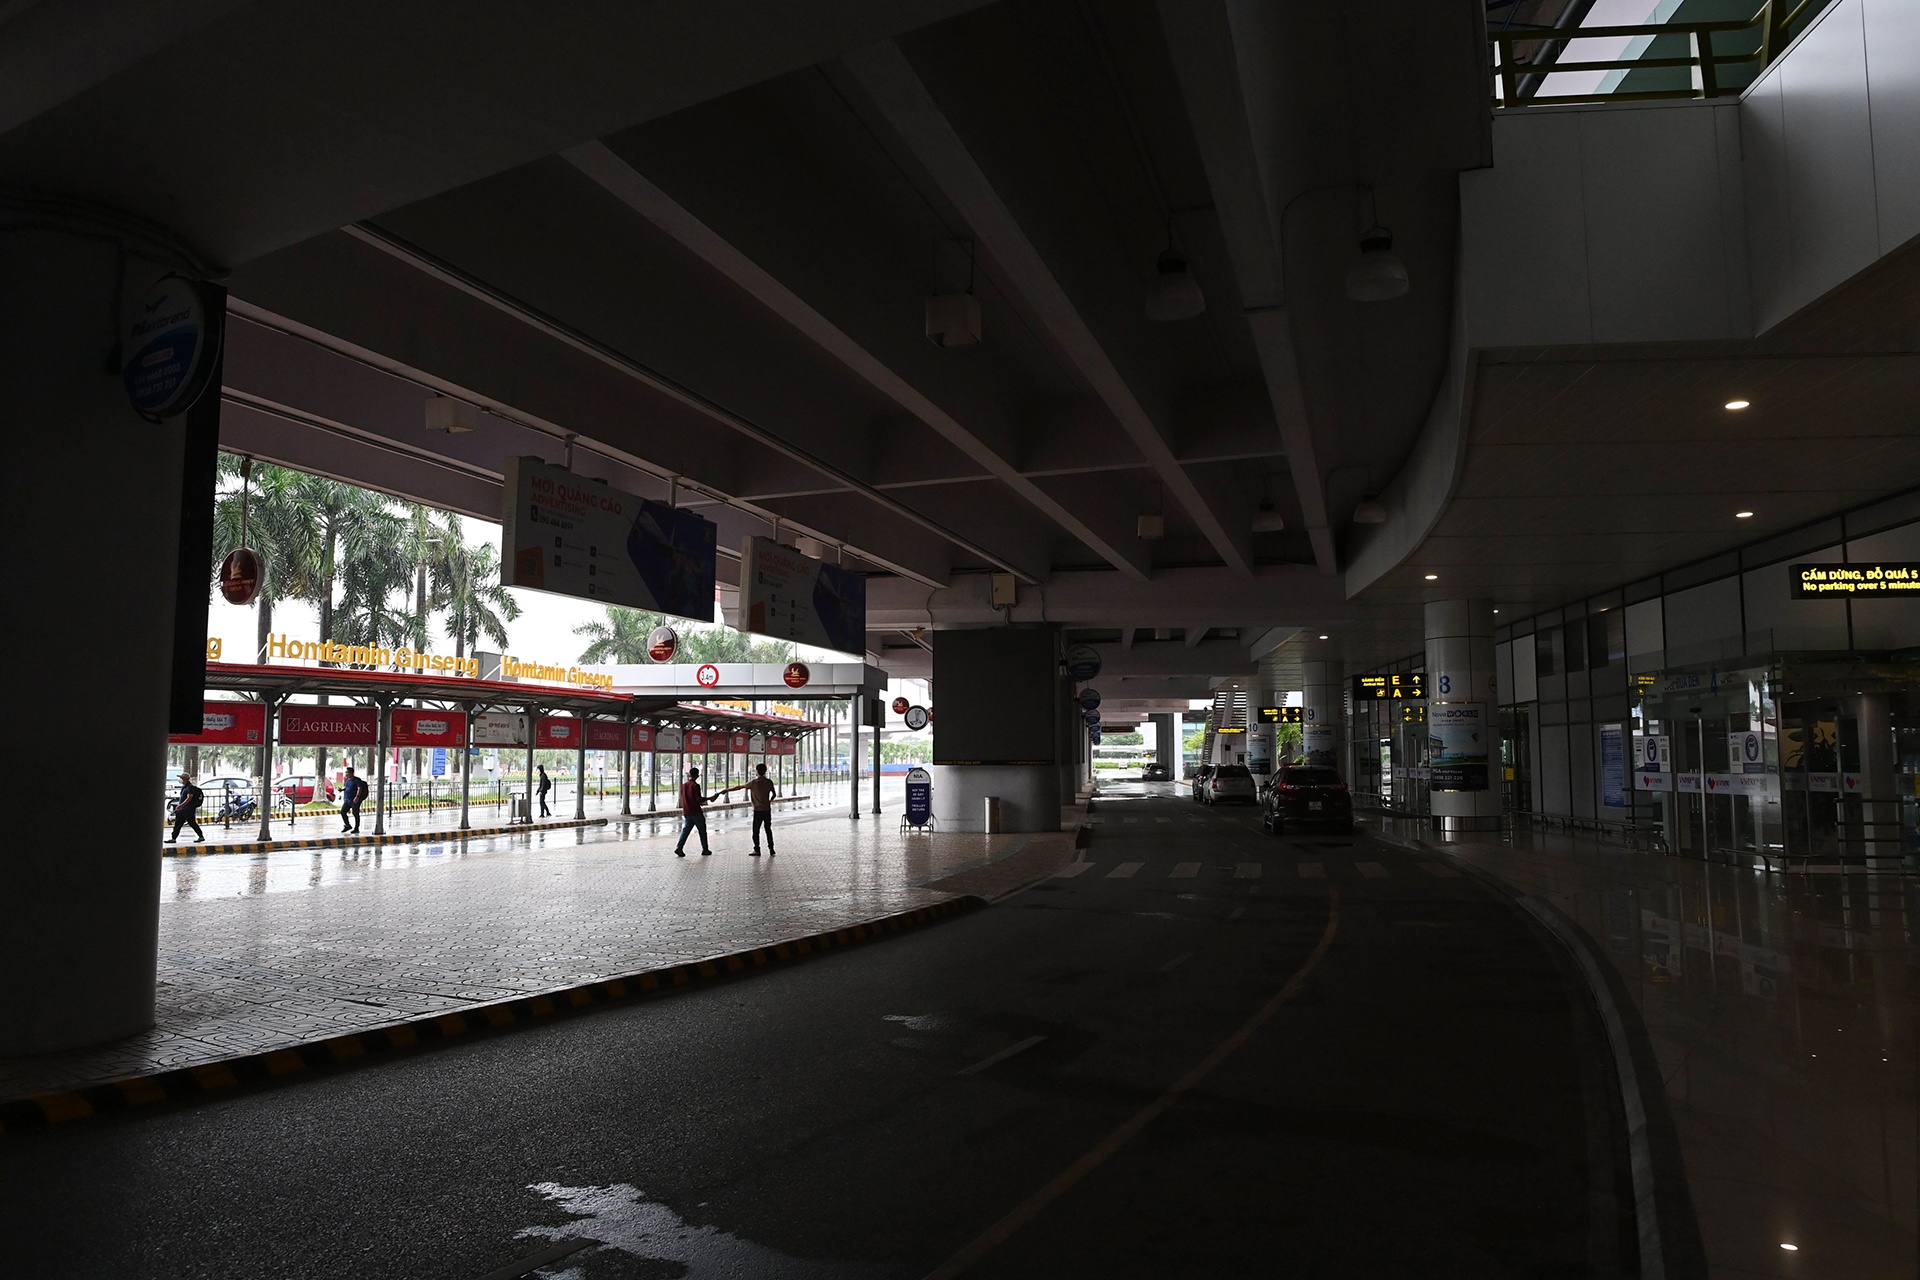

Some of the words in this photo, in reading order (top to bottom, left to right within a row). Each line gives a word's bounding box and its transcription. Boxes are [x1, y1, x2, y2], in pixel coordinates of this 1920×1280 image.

[531, 493, 586, 517] ADVERTISING
[558, 485, 597, 508] QUẢNG
[600, 497, 622, 515] CÁO
[1801, 568, 1827, 580] CẤM
[1866, 567, 1883, 580] ĐỖ
[1884, 567, 1910, 580] QUÁ
[1910, 569, 1920, 580] 5
[1802, 582, 1818, 591] No
[1818, 581, 1855, 592] parking
[1856, 582, 1879, 590] over
[1879, 580, 1887, 590] 5
[267, 633, 390, 666] Homtamin
[395, 647, 479, 677] Ginseng
[501, 655, 567, 682] Homtamin
[567, 666, 613, 691] Ginseng
[1392, 675, 1400, 685] E
[1439, 675, 1451, 694] 8
[1393, 688, 1402, 698] A
[1308, 708, 1315, 720] 9
[302, 722, 371, 734] AGRIBANK
[1248, 723, 1258, 732] 10
